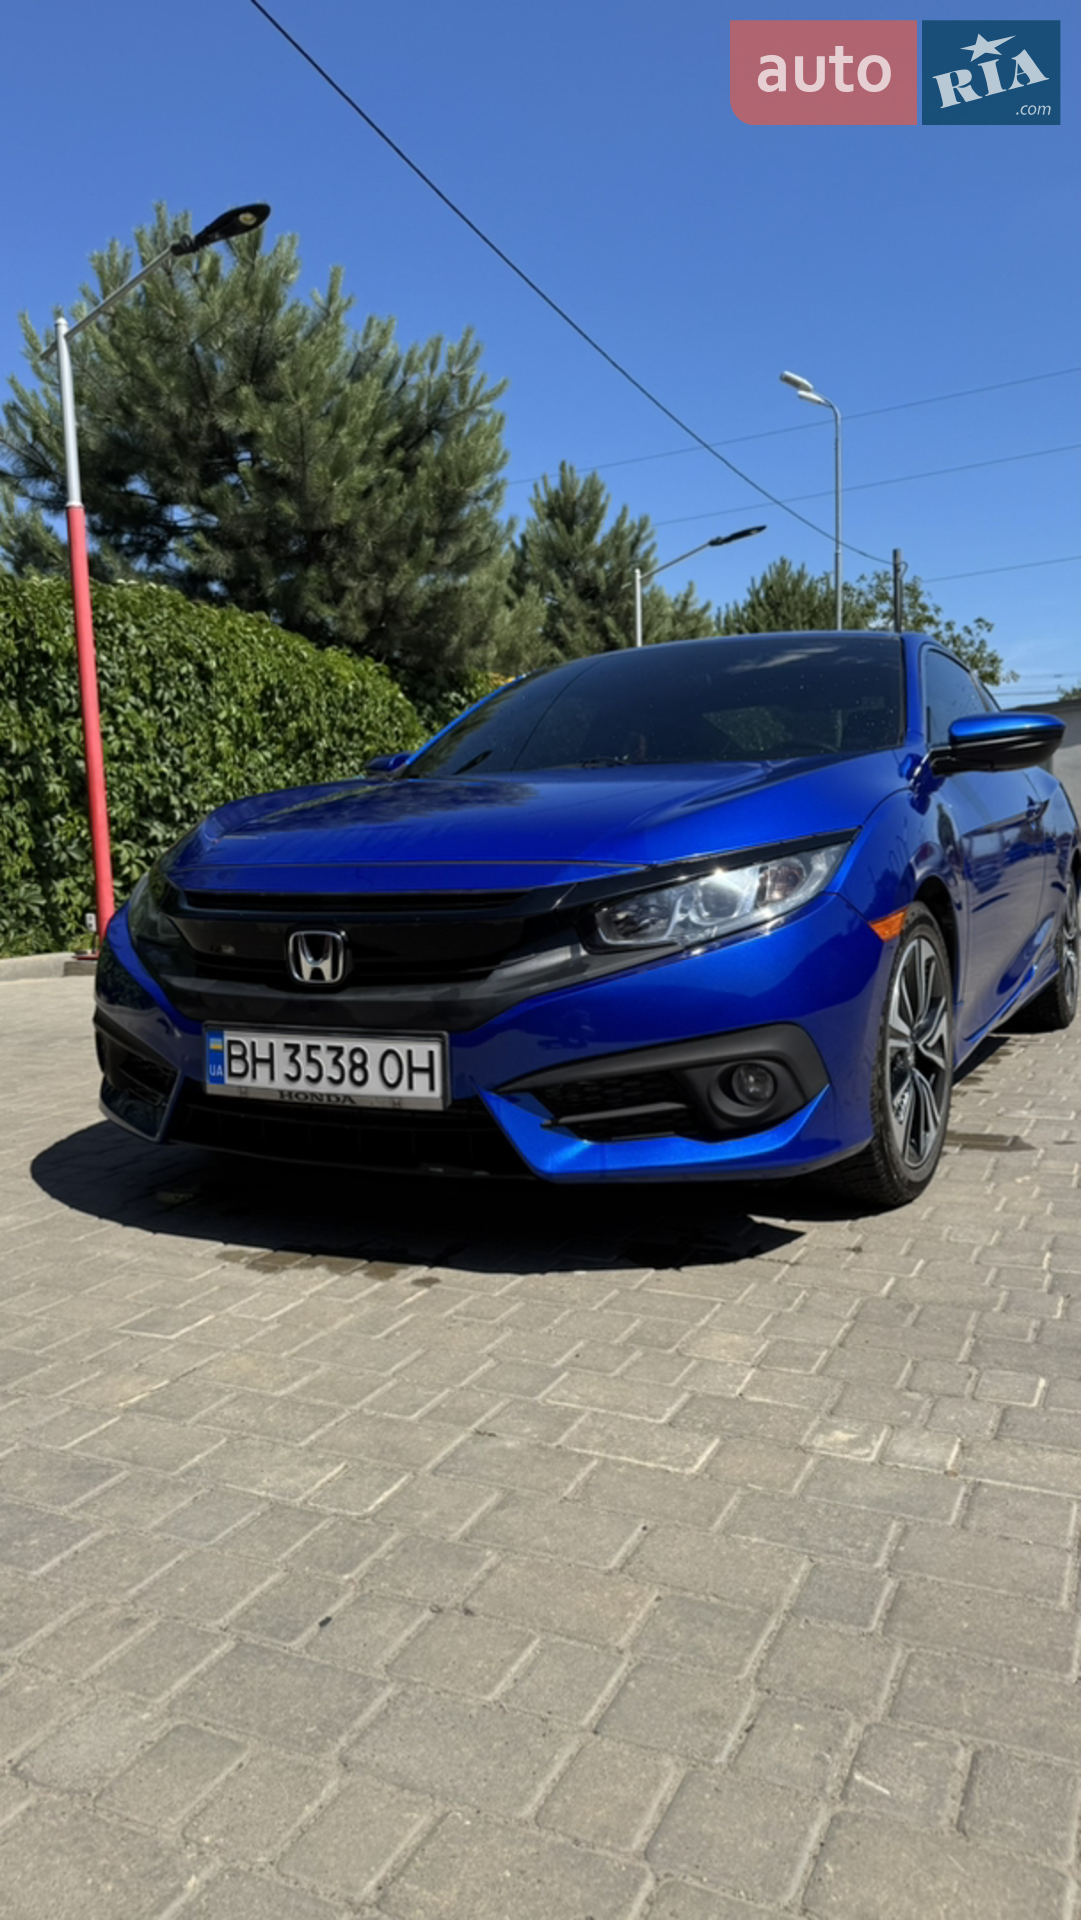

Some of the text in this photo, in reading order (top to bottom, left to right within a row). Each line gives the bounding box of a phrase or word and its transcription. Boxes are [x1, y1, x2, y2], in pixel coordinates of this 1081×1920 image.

[209, 1065, 224, 1077] UA
[227, 1039, 435, 1092] BH 3538 OH
[278, 1090, 356, 1105] HONDA
